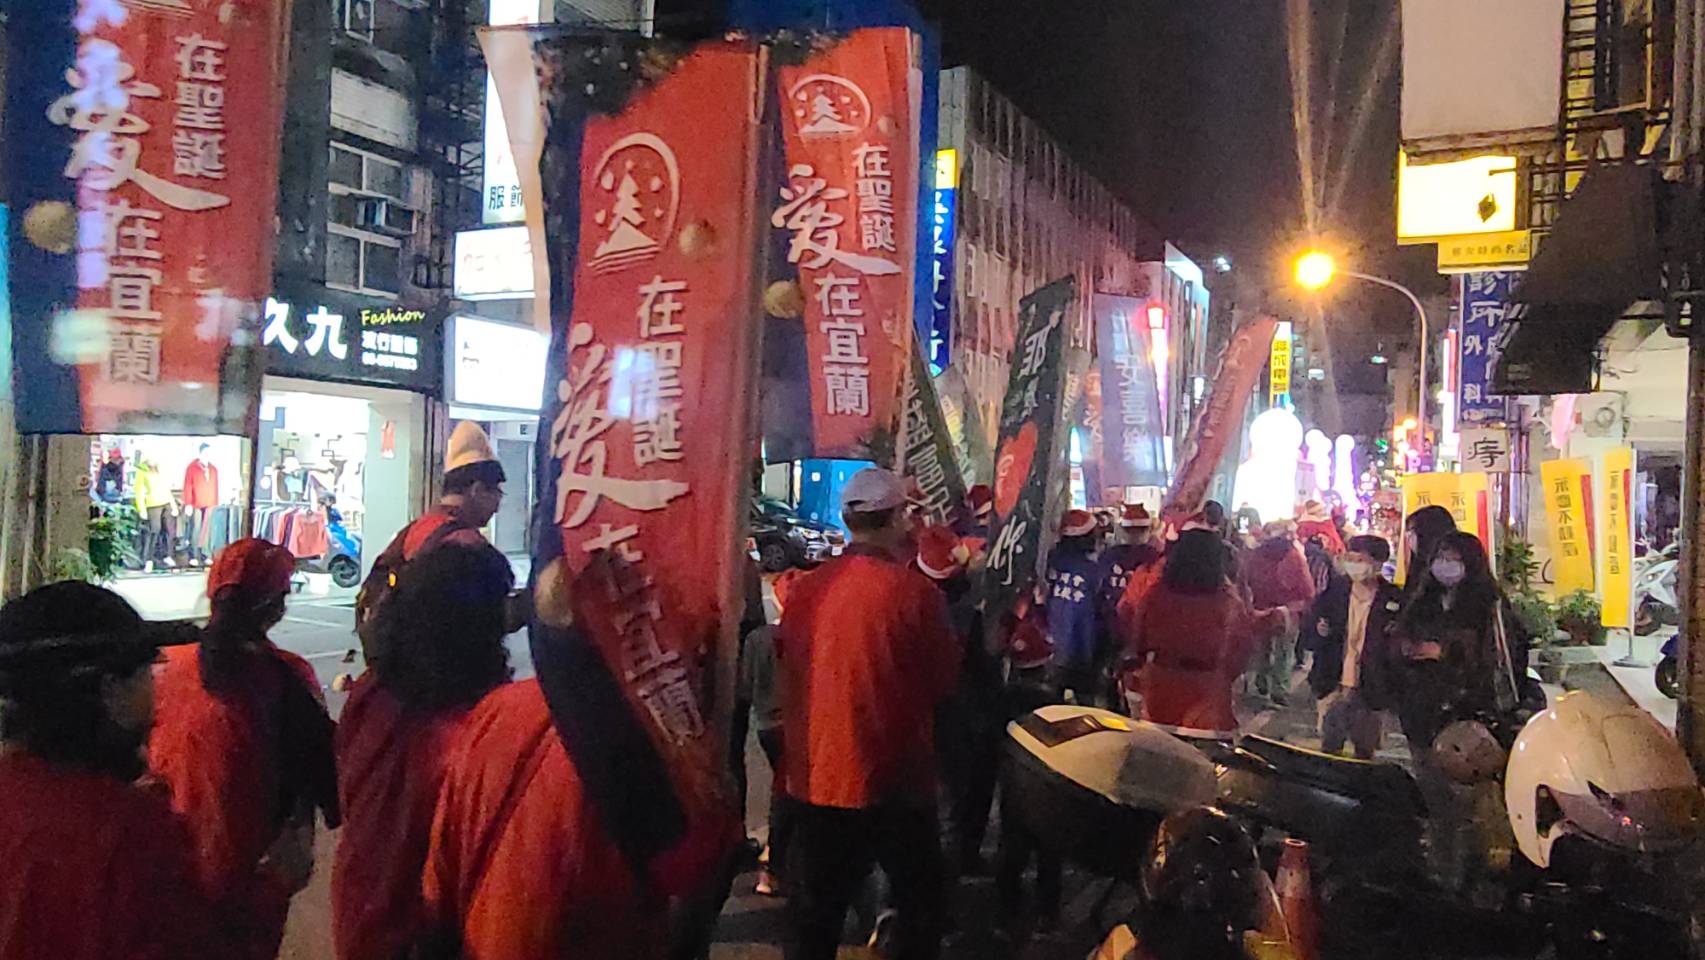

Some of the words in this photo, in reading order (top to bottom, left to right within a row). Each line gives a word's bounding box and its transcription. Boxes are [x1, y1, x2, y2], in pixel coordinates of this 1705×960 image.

[46, 38, 231, 211] 愛
[174, 33, 229, 179] 在聖誕
[771, 164, 903, 276] 愛
[854, 142, 897, 251] 在聖誕
[106, 200, 164, 386] 在宜蘭
[264, 297, 348, 361] 久九
[361, 307, 426, 326] Fashion
[814, 272, 872, 416] 在宜蘭
[552, 321, 691, 529] 愛
[633, 275, 689, 467] 在聖誕
[1464, 335, 1483, 404] 外科
[1467, 437, 1505, 468] 痔
